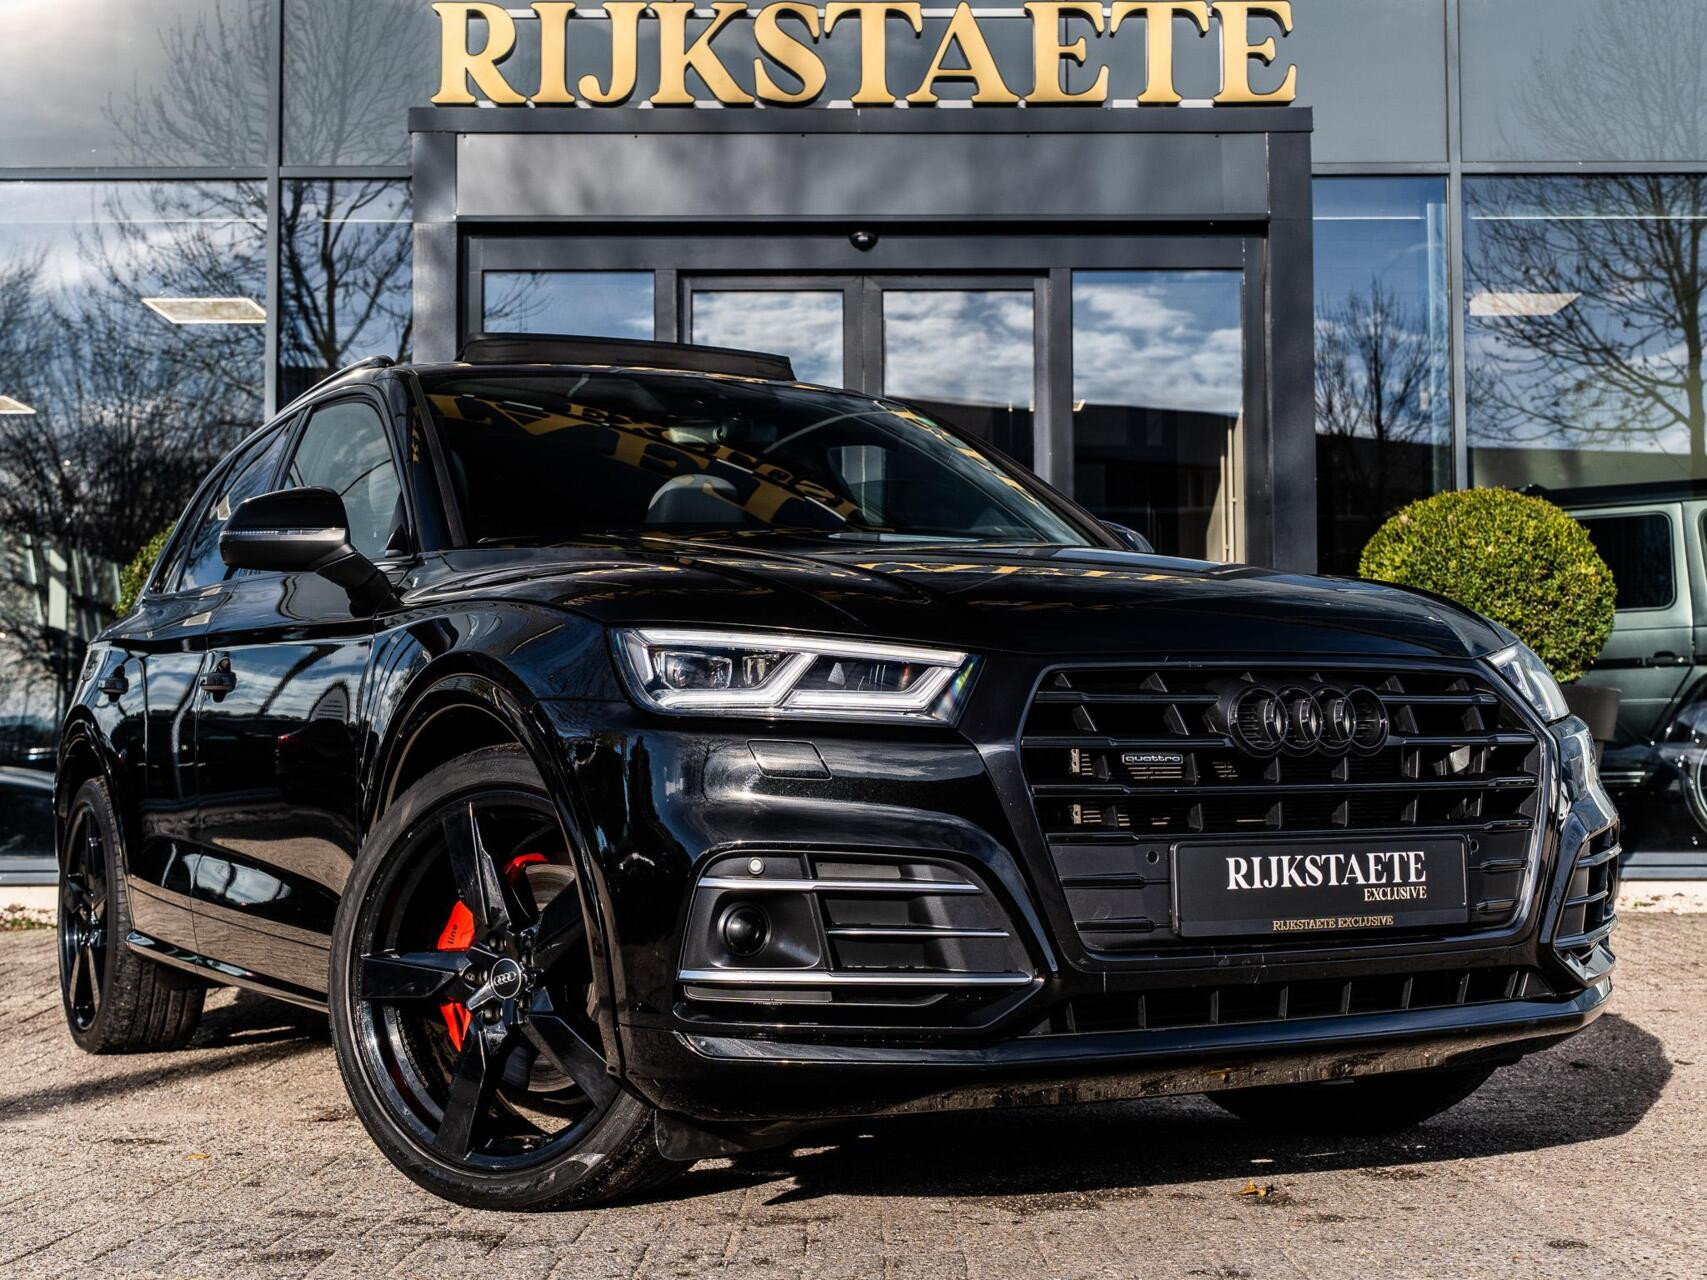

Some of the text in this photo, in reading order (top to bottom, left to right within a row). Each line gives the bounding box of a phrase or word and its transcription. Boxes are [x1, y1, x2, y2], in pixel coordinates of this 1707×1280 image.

[431, 1, 1298, 107] RIJKSTAETE
[1125, 755, 1181, 764] quattro
[1225, 851, 1427, 890] RIJKSTAETE
[1363, 885, 1428, 902] EXCLUSIVE
[1272, 914, 1394, 931] RIJKSTAETE EXCLUSIVE
